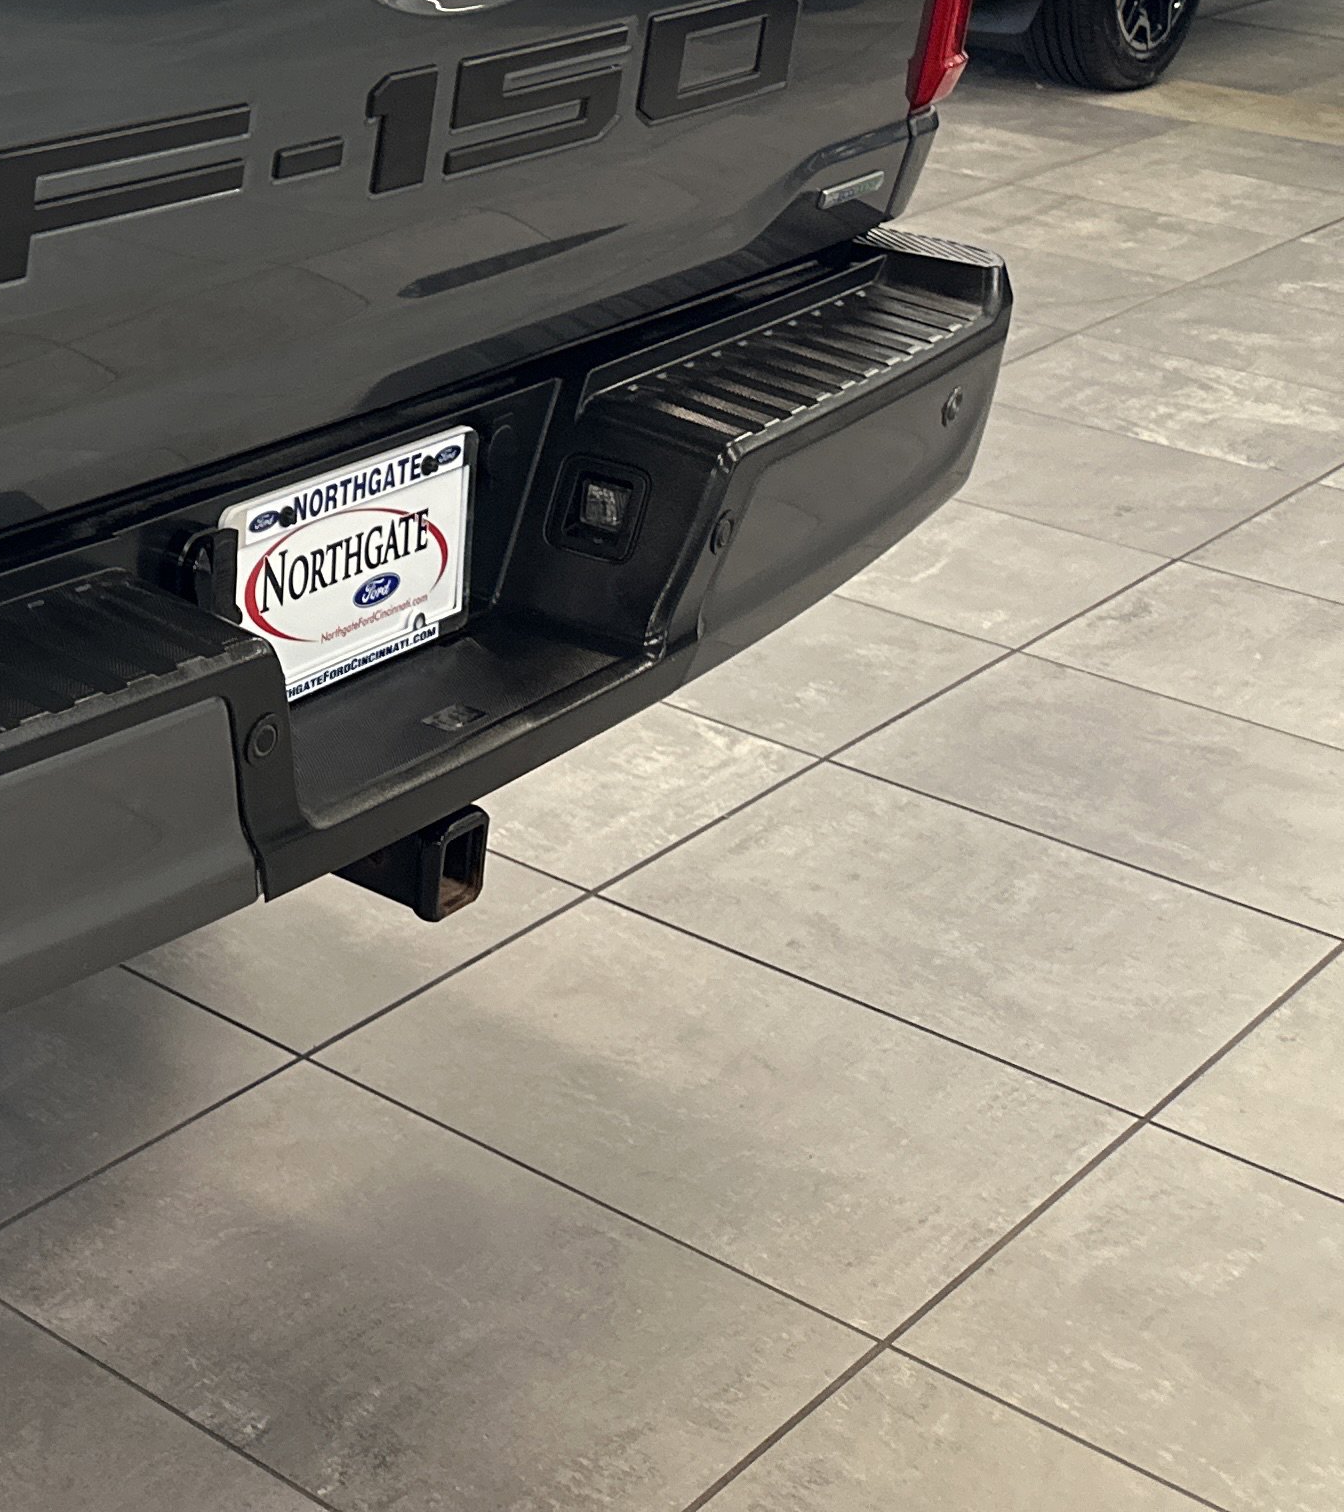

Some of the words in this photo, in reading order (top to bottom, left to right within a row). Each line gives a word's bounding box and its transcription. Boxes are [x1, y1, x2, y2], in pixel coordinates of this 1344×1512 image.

[292, 452, 423, 525] NORTHGATE
[259, 507, 430, 614] NORTHGATE
[360, 578, 393, 604] Ford
